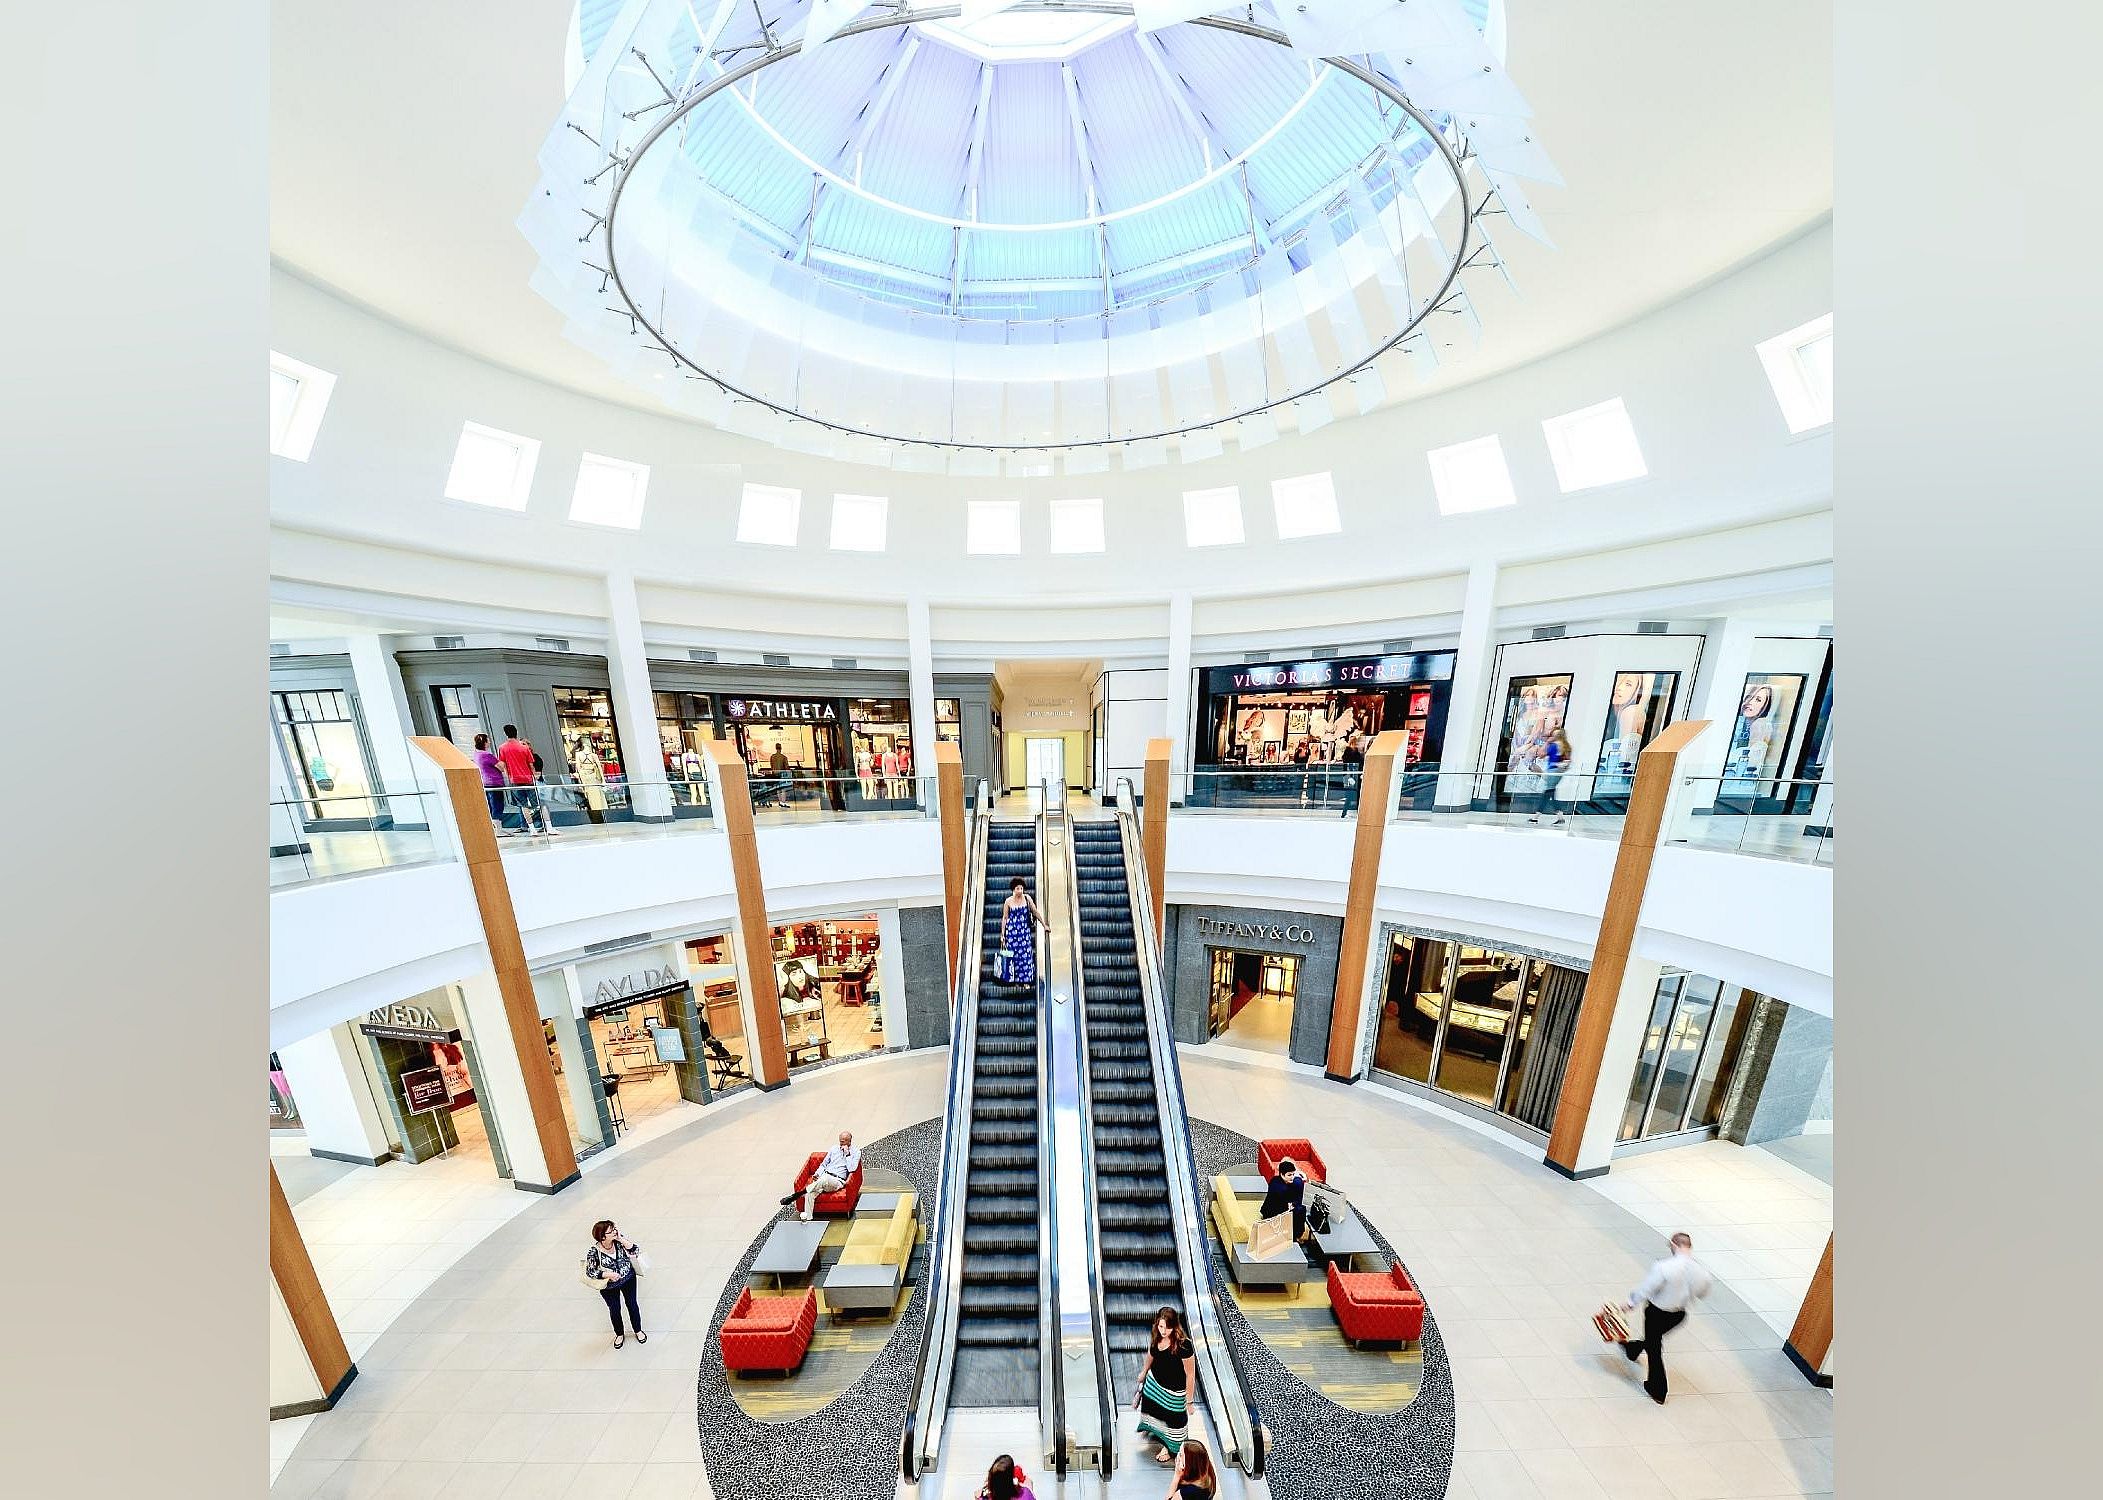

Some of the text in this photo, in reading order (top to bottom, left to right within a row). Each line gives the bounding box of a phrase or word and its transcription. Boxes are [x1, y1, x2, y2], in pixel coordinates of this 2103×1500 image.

[1341, 663, 1411, 680] SECRET
[749, 701, 836, 719] ATHLETA
[1198, 916, 1268, 938] TIFFANY
[367, 1004, 441, 1031] AVEDA
